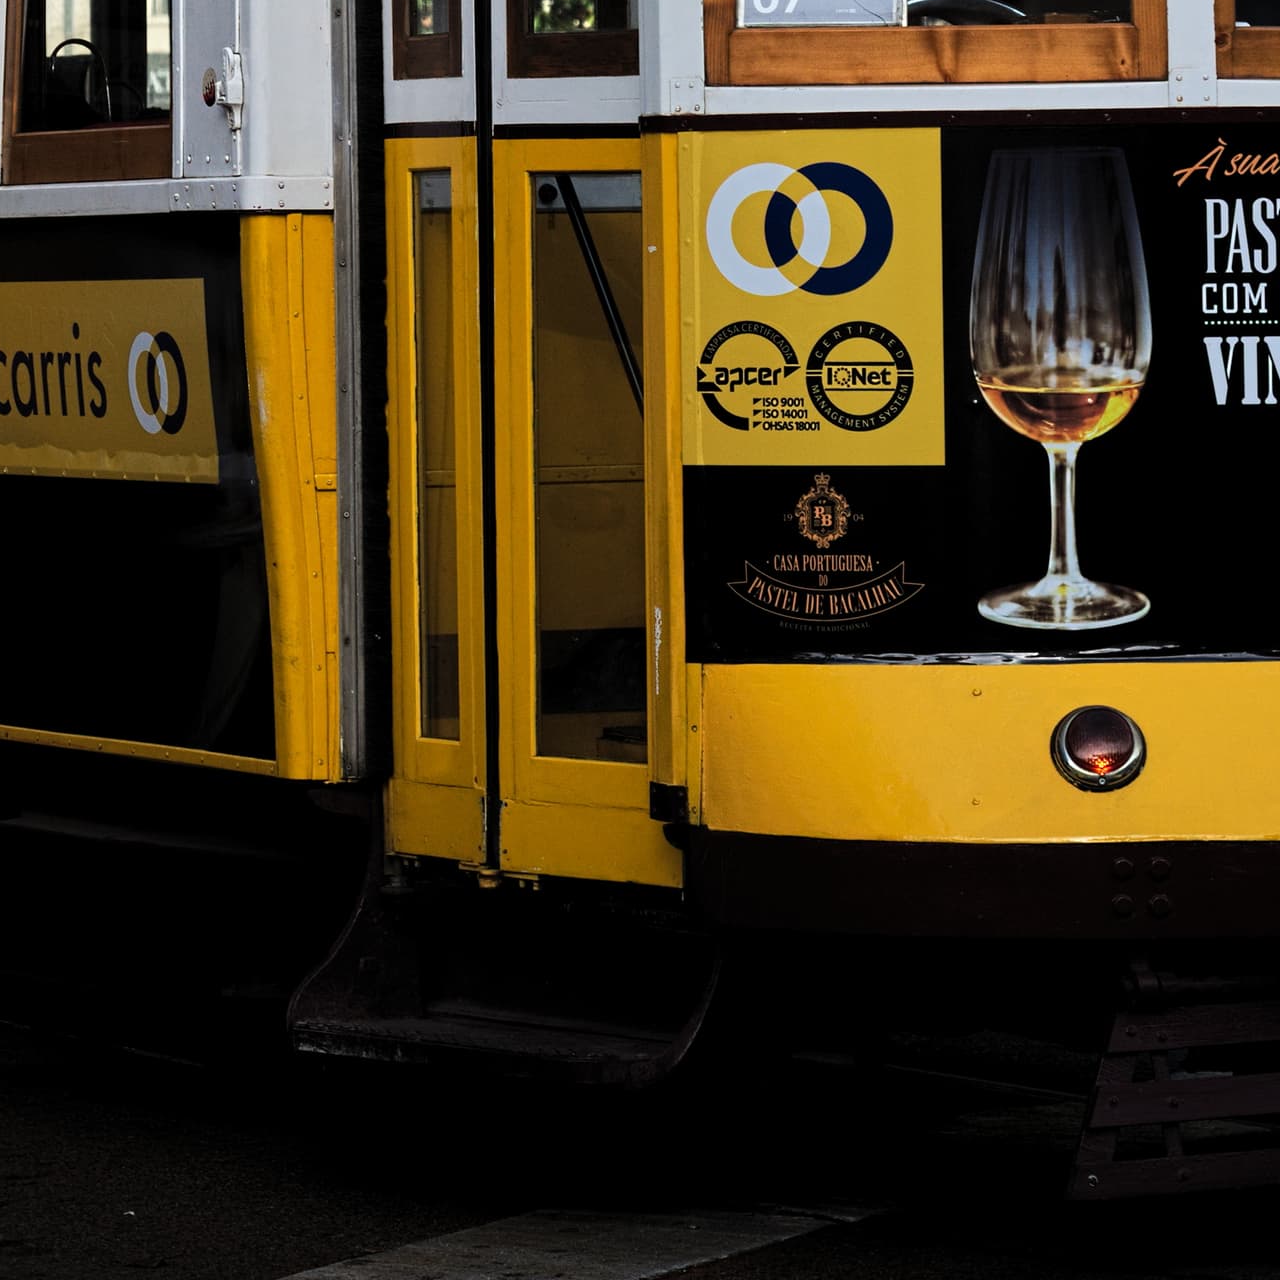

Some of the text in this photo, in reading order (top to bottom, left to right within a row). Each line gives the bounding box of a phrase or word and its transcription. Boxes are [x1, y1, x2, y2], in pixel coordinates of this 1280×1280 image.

[1173, 137, 1228, 187] À
[1201, 281, 1268, 314] COM
[704, 322, 794, 360] EMPRESA CERTIFICADA
[815, 325, 905, 359] CERTIFIED
[714, 367, 782, 392] apcer
[827, 367, 892, 388] IQNet
[762, 398, 805, 408] ISO 9001
[762, 409, 808, 419] ISO 14001
[811, 383, 910, 429] MANAGEMENT SYSTEM
[762, 421, 820, 431] OHSAS 18001
[774, 554, 874, 572] CASA PORTUGUESA
[819, 574, 829, 587] DO
[747, 575, 905, 615] PASTEL DE BACALHAU
